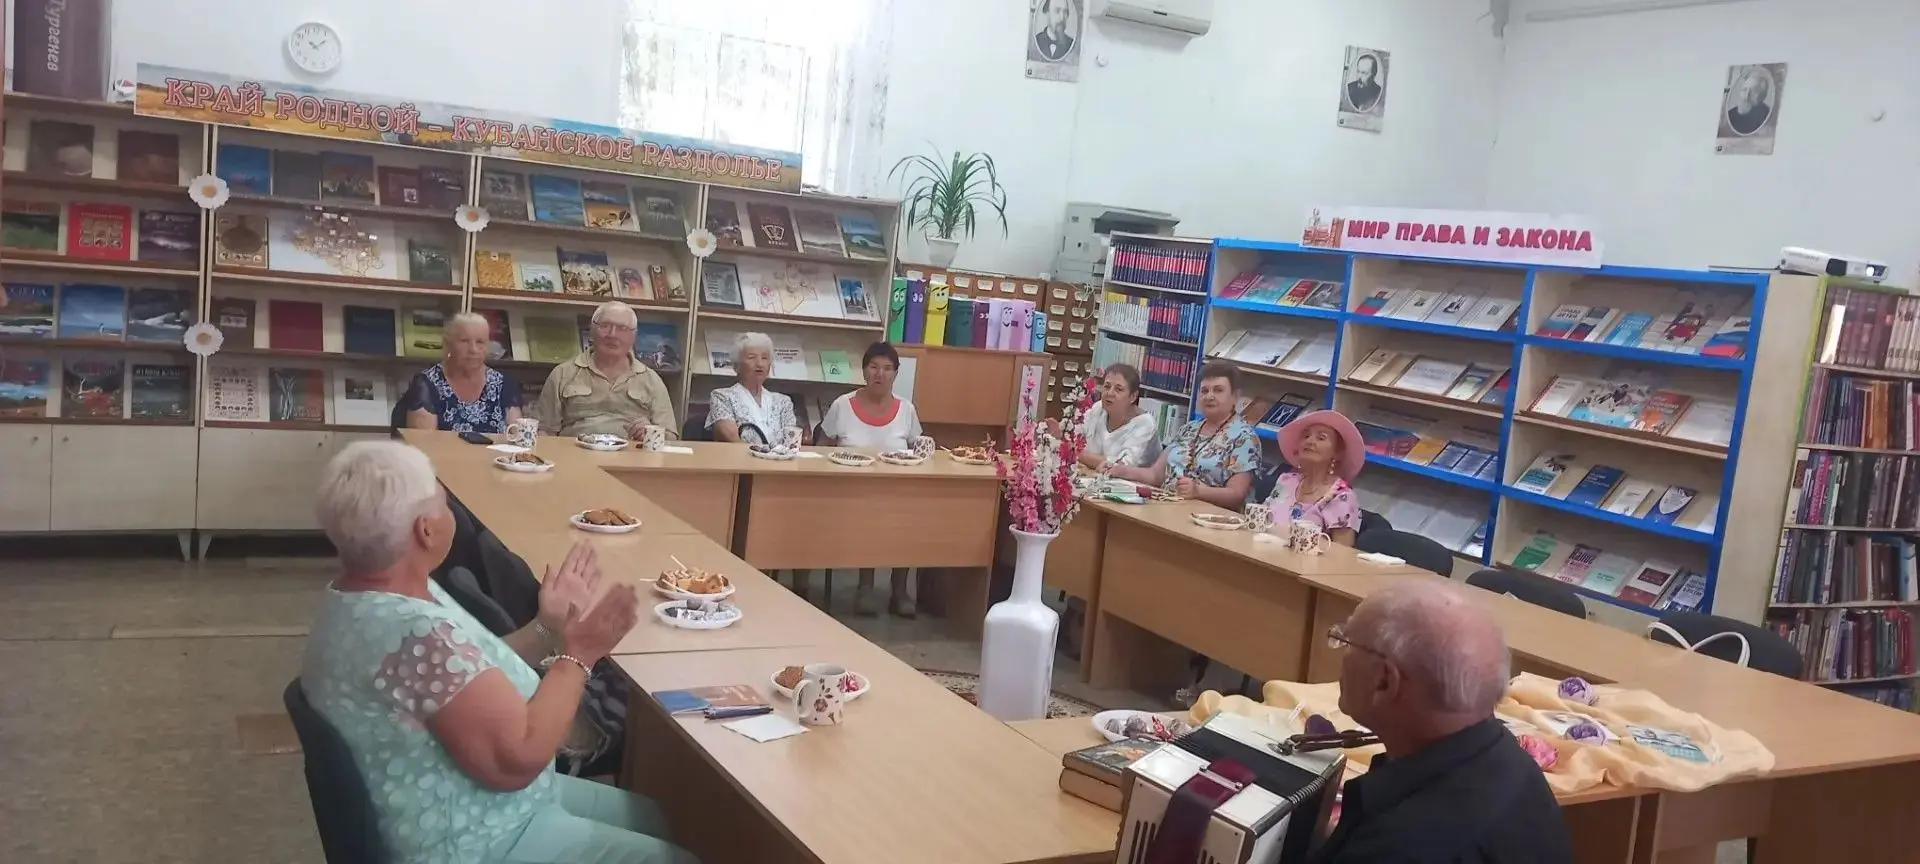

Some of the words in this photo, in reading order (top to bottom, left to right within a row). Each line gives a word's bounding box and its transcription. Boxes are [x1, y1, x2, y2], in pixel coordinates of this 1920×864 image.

[44, 0, 66, 71] Тургенев
[165, 78, 265, 117] КРАЙ
[274, 91, 420, 136] РОДНОЙ
[450, 115, 635, 163] КУБАНСКОЕ
[642, 141, 783, 182] РАЗДОЛЬЕ
[1347, 219, 1390, 239] МИР
[1395, 222, 1466, 245] ПРАВА
[1472, 226, 1490, 246] И
[1495, 226, 1593, 252] ЗАКОНА
